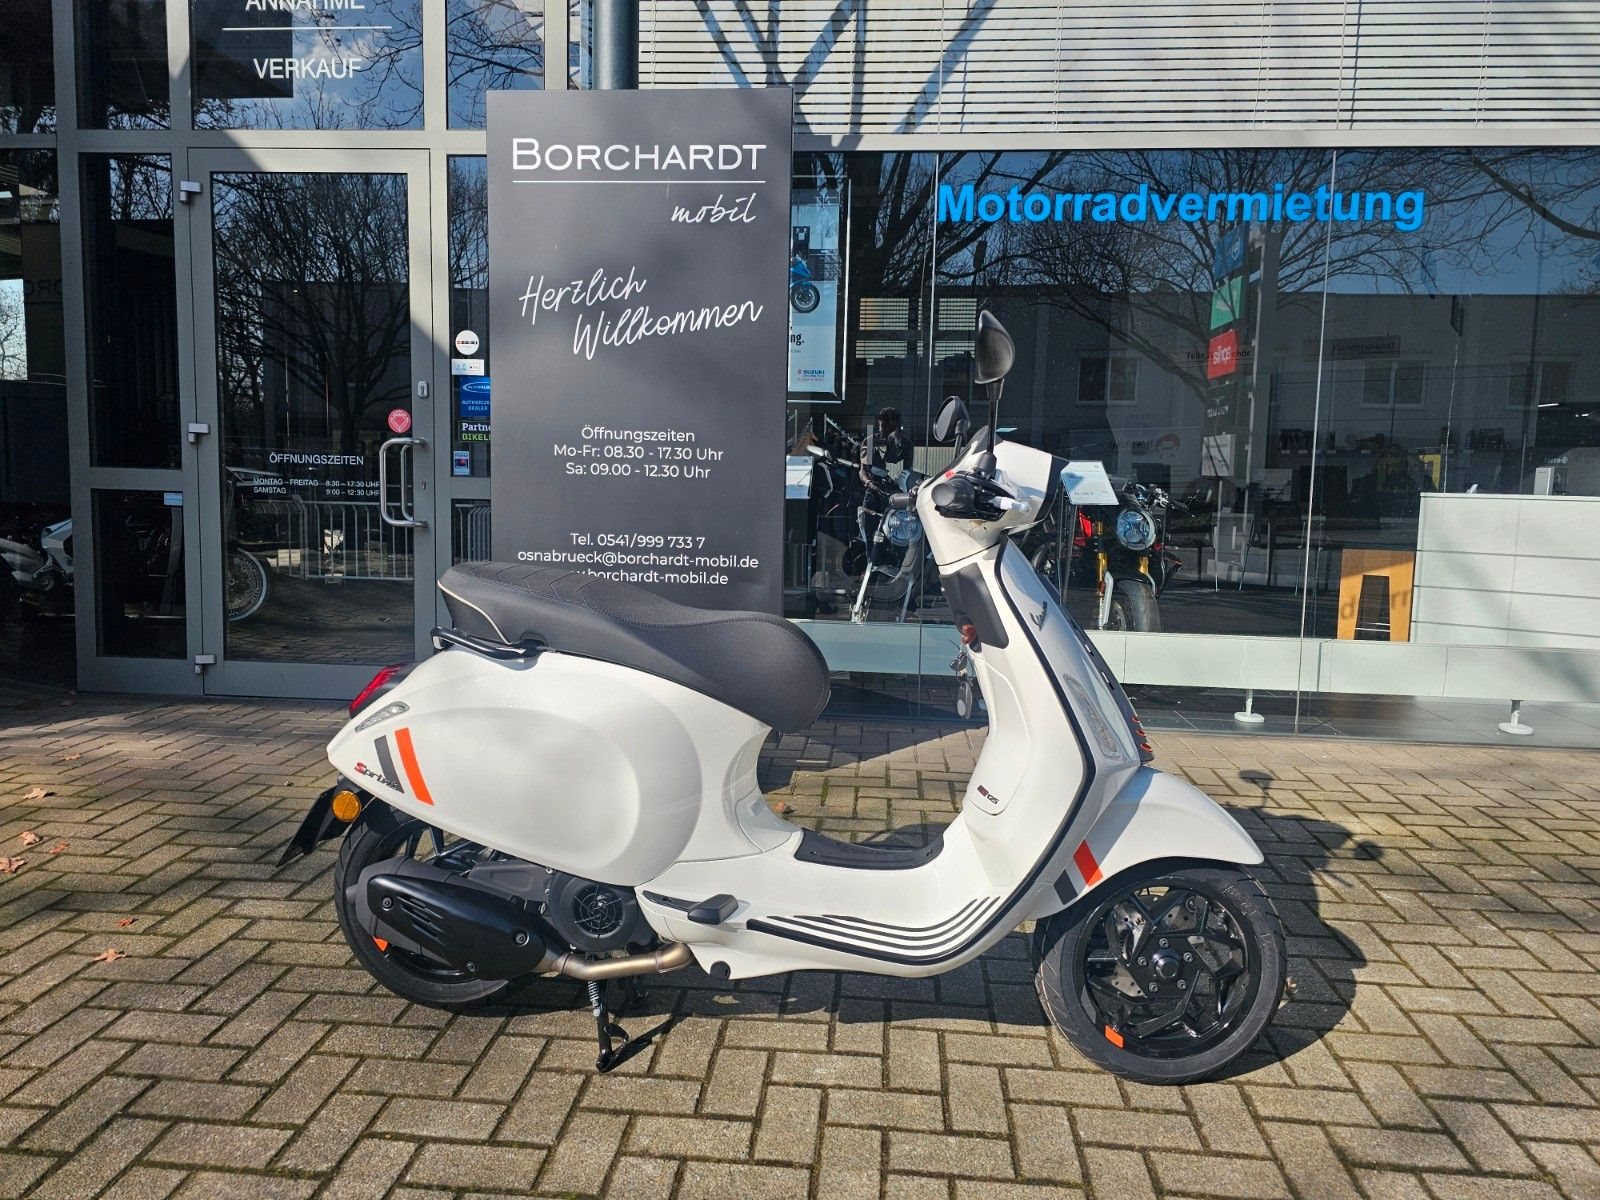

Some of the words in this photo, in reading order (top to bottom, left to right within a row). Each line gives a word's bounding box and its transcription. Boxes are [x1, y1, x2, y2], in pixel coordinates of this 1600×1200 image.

[253, 58, 363, 79] VERKAUF
[670, 192, 757, 224] mobil
[937, 182, 1425, 232] Motorradvermietung
[519, 266, 647, 325] Herzlich
[573, 300, 763, 361] Willkommen
[581, 425, 695, 443] Öffnungszeiten
[269, 452, 364, 466] ÖFFNUNGSZEITEN
[553, 444, 600, 458] Mo-Fr:
[604, 445, 644, 459] 08.30
[658, 447, 692, 460] 17.30
[697, 447, 724, 461] Uhr
[565, 462, 587, 475] Sa:
[590, 463, 631, 477] 09.00
[644, 464, 680, 478] 12.30
[684, 465, 711, 479] Uhr
[253, 478, 283, 486] MONTAG
[253, 486, 287, 494] SAMSTAG
[570, 533, 594, 546] Tel.
[597, 533, 664, 549] 0541/999
[517, 549, 759, 568] osnabrueck@borchardt-mobil.de
